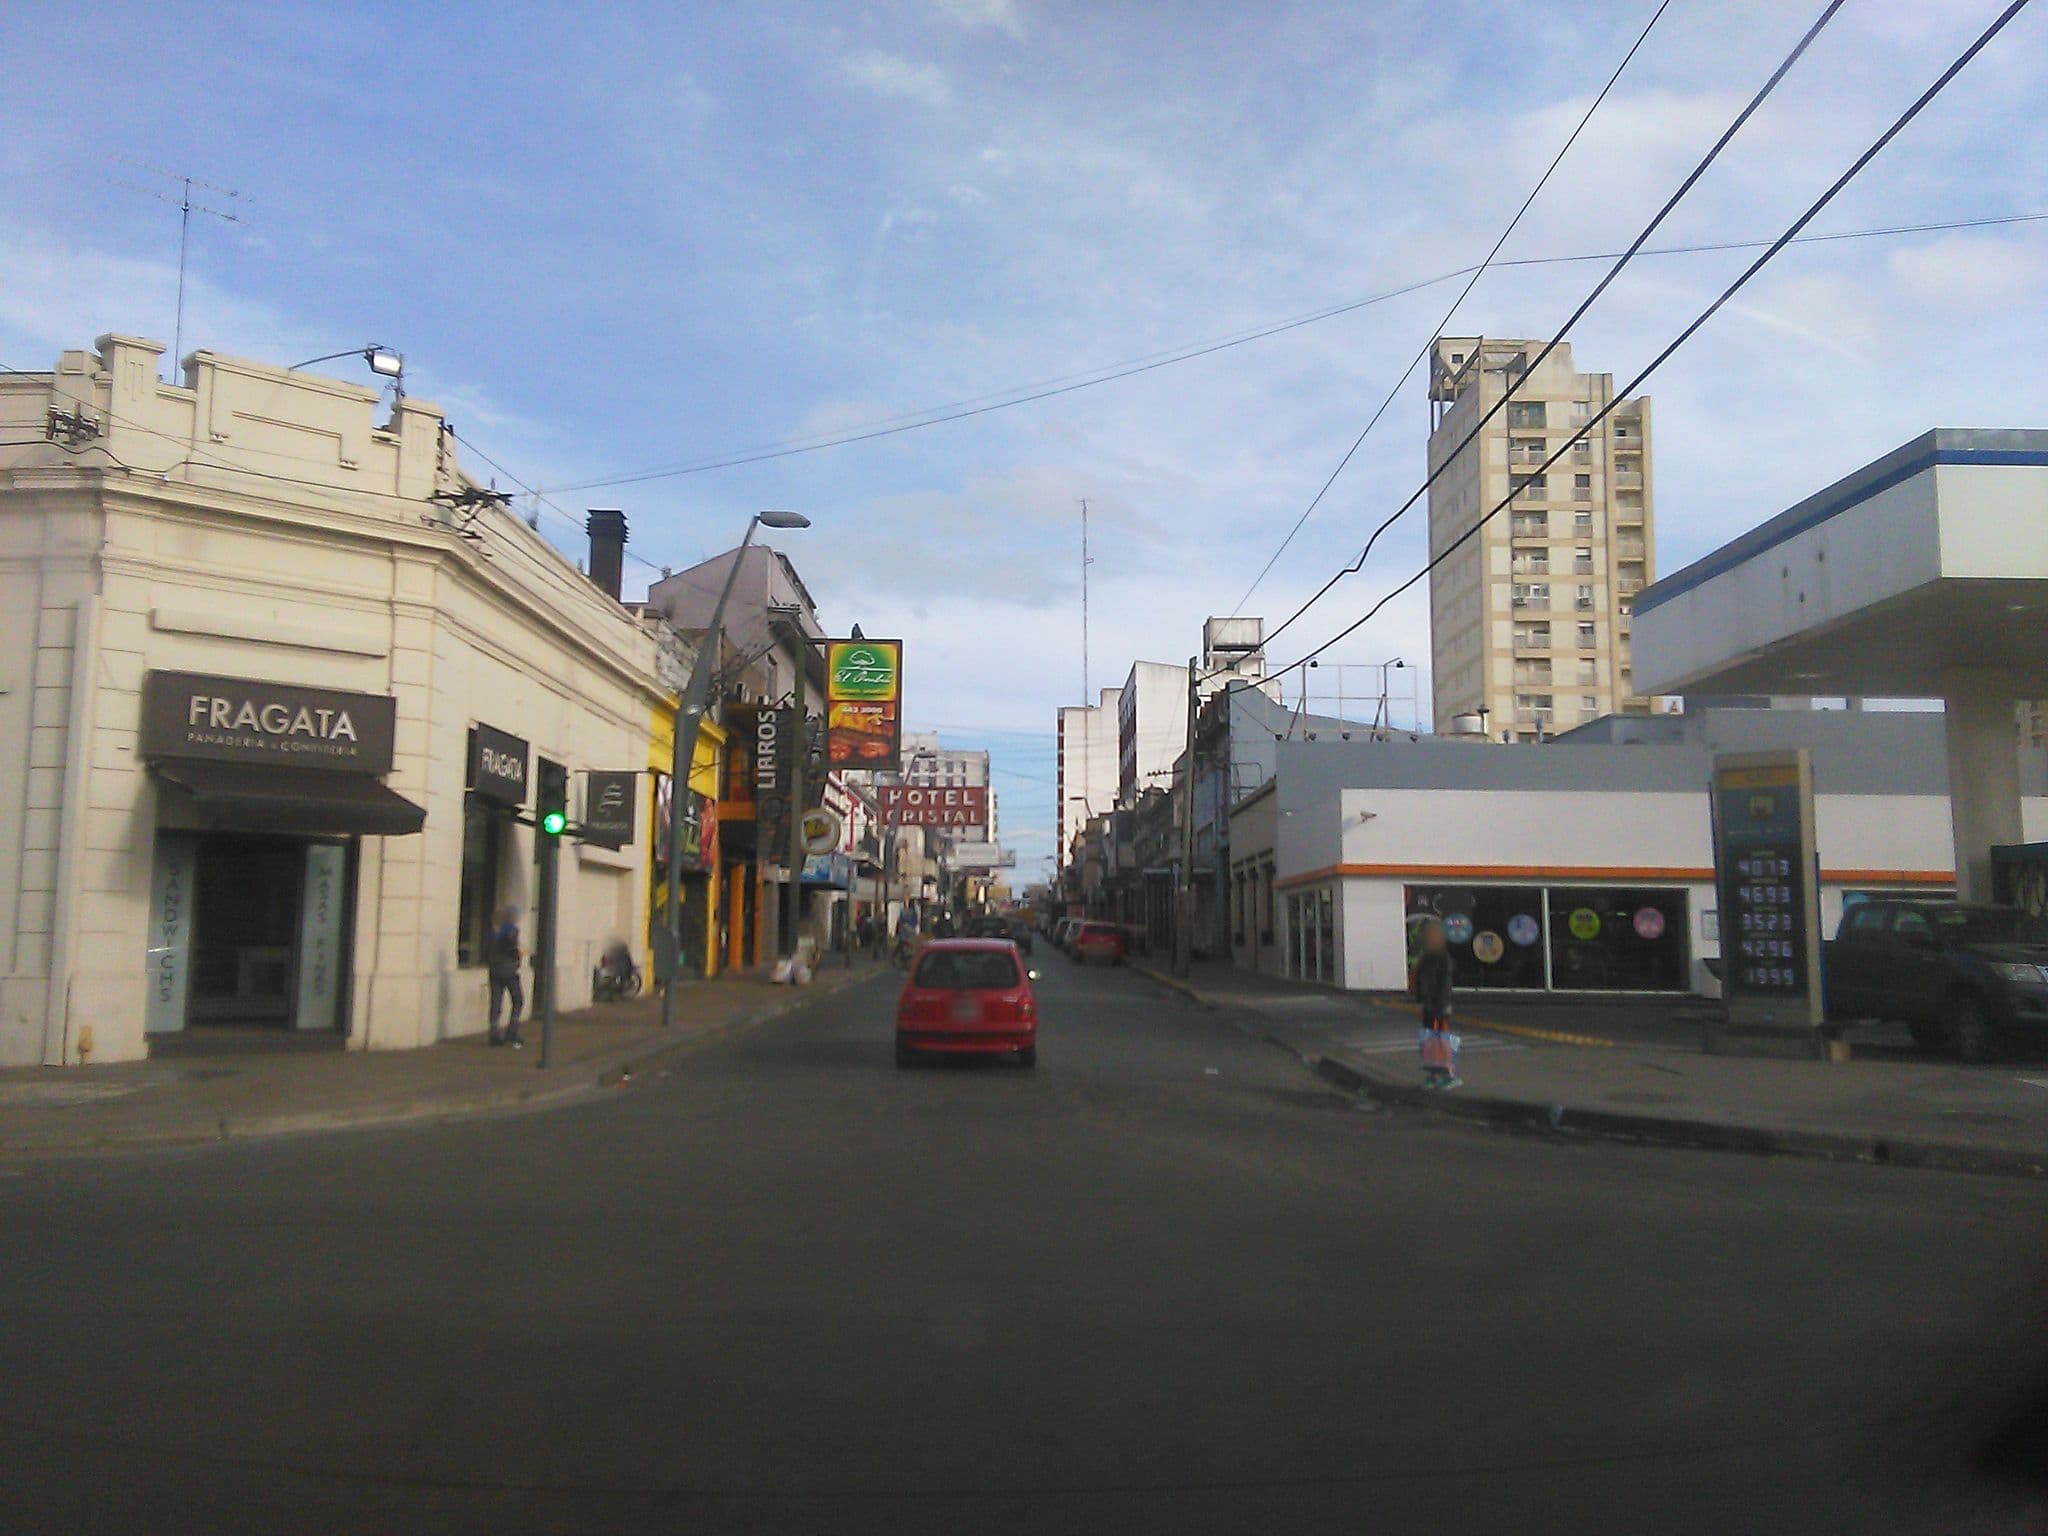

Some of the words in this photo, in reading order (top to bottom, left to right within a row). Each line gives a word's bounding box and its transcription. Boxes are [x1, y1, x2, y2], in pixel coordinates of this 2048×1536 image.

[189, 695, 357, 742] FRAGATA
[481, 748, 523, 783] FRAGATA
[889, 790, 975, 806] HOTEL
